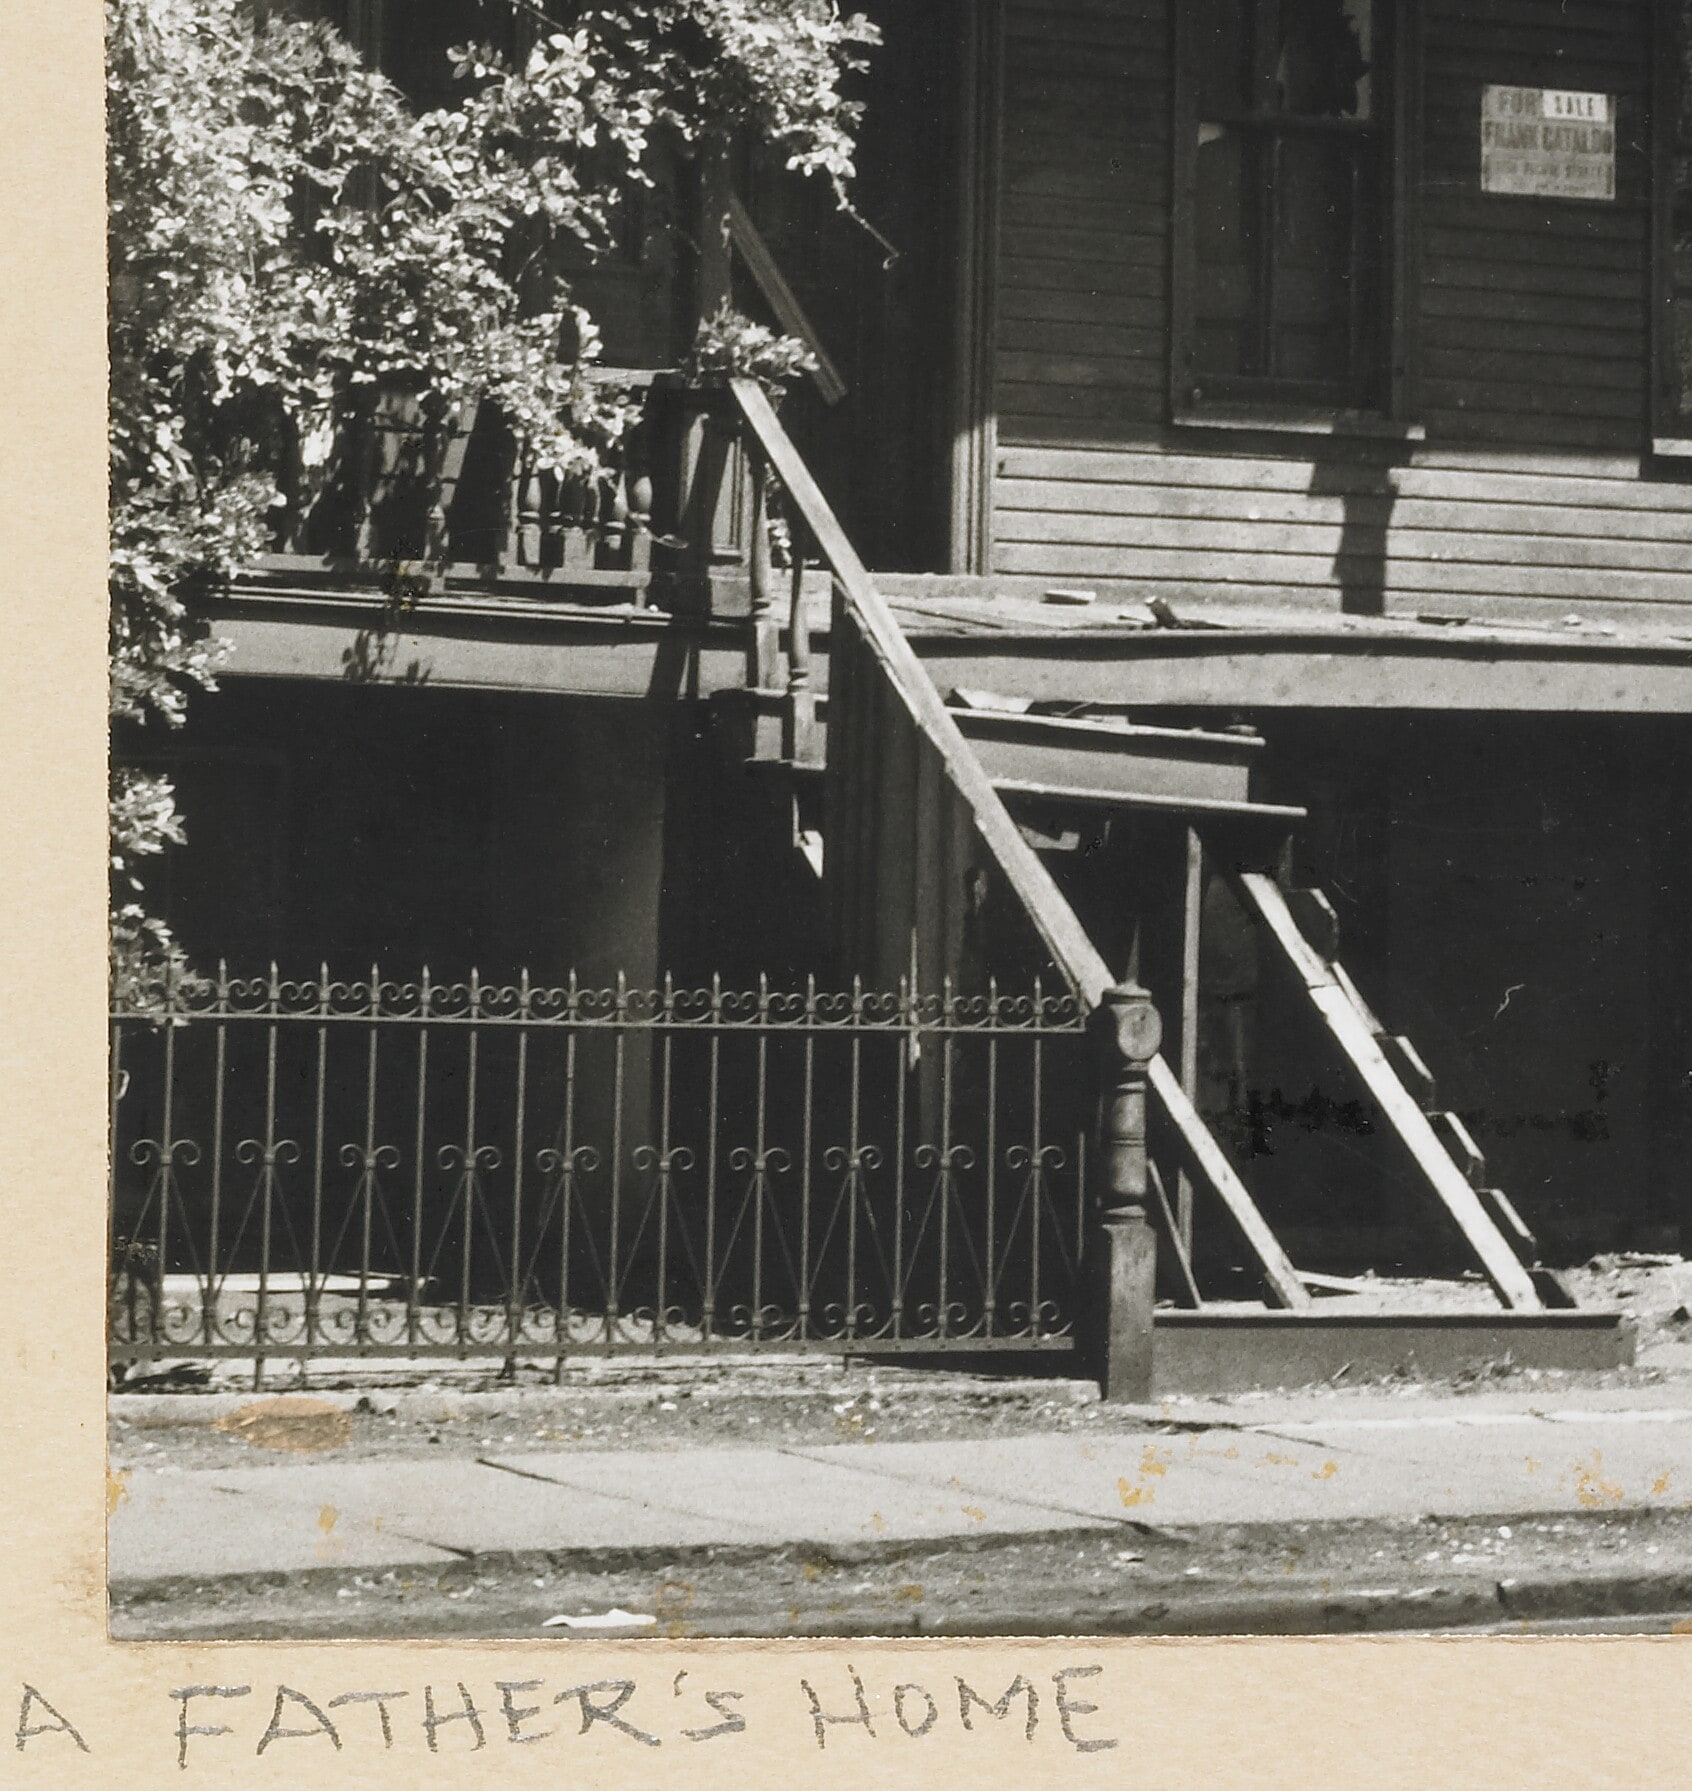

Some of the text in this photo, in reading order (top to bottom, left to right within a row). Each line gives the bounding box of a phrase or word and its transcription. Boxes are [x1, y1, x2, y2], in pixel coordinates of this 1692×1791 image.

[1497, 91, 1594, 117] FOR SALE
[14, 1681, 92, 1754] A
[799, 1664, 1118, 1754] HOME
